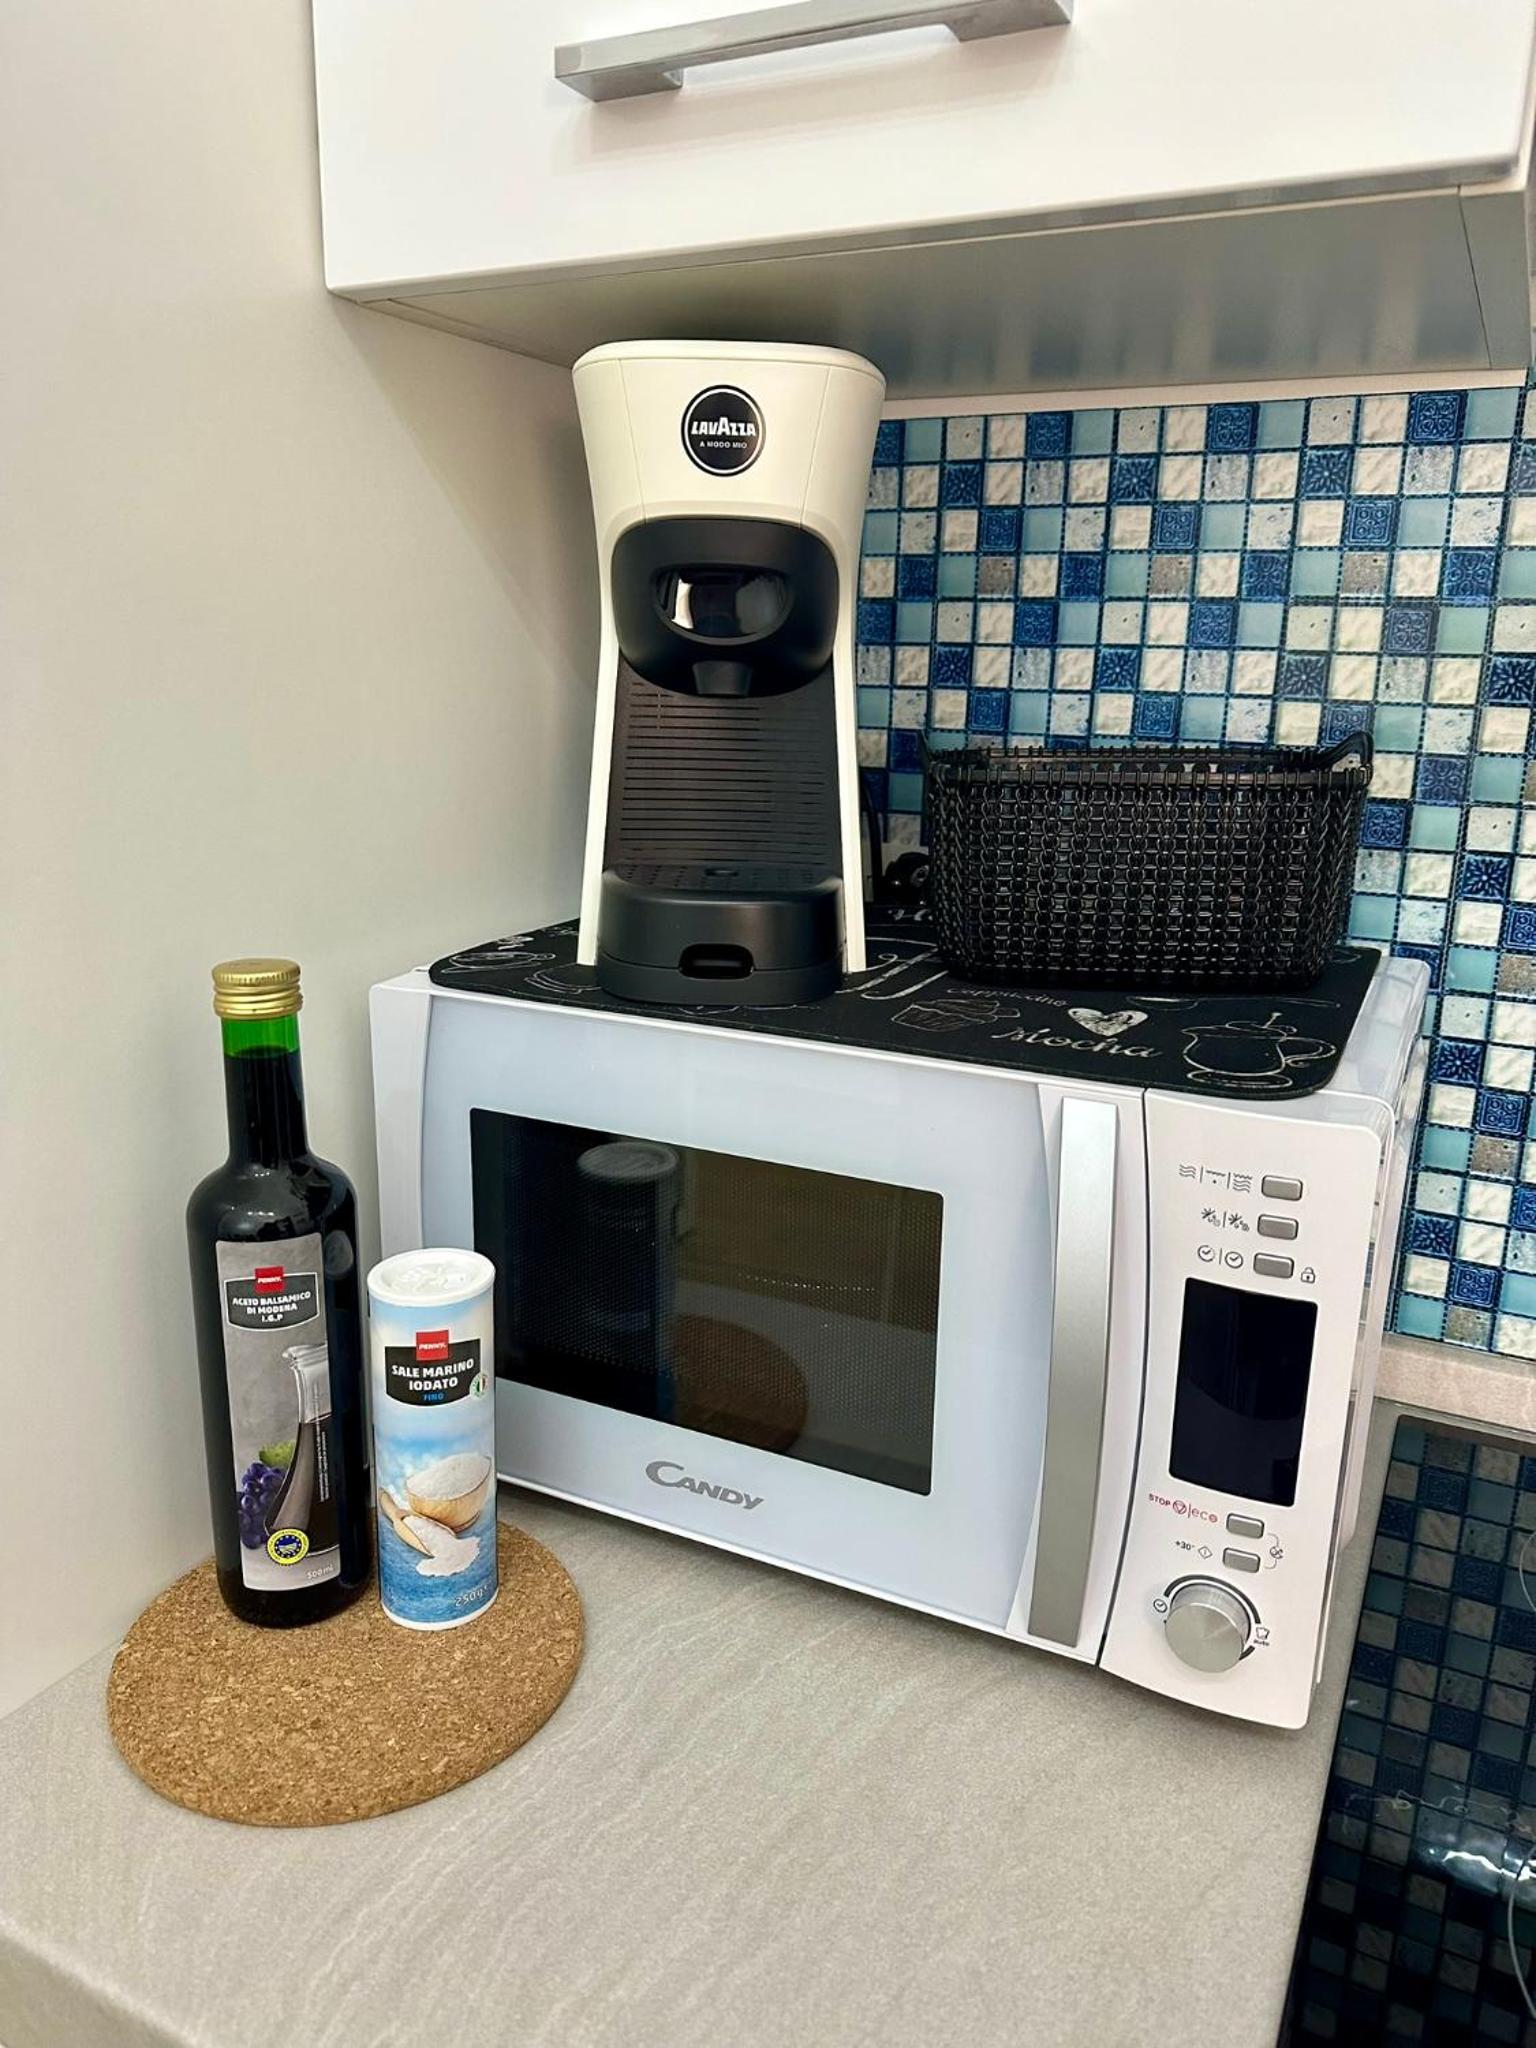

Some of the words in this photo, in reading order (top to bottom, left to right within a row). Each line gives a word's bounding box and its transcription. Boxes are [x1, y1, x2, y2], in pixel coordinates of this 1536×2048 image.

[691, 417, 756, 436] LAVAZZA
[699, 440, 706, 448] A
[732, 442, 748, 450] MIO
[991, 1027, 1162, 1058] Mocha
[232, 1297, 259, 1307] ACETO
[260, 1291, 312, 1306] BALSAMICO
[246, 1306, 257, 1315] DI
[258, 1303, 298, 1314] MODENA
[391, 1364, 421, 1378] SALE
[422, 1358, 475, 1378] MARINO
[408, 1376, 459, 1391] IODATO
[1148, 1493, 1171, 1507] STOP
